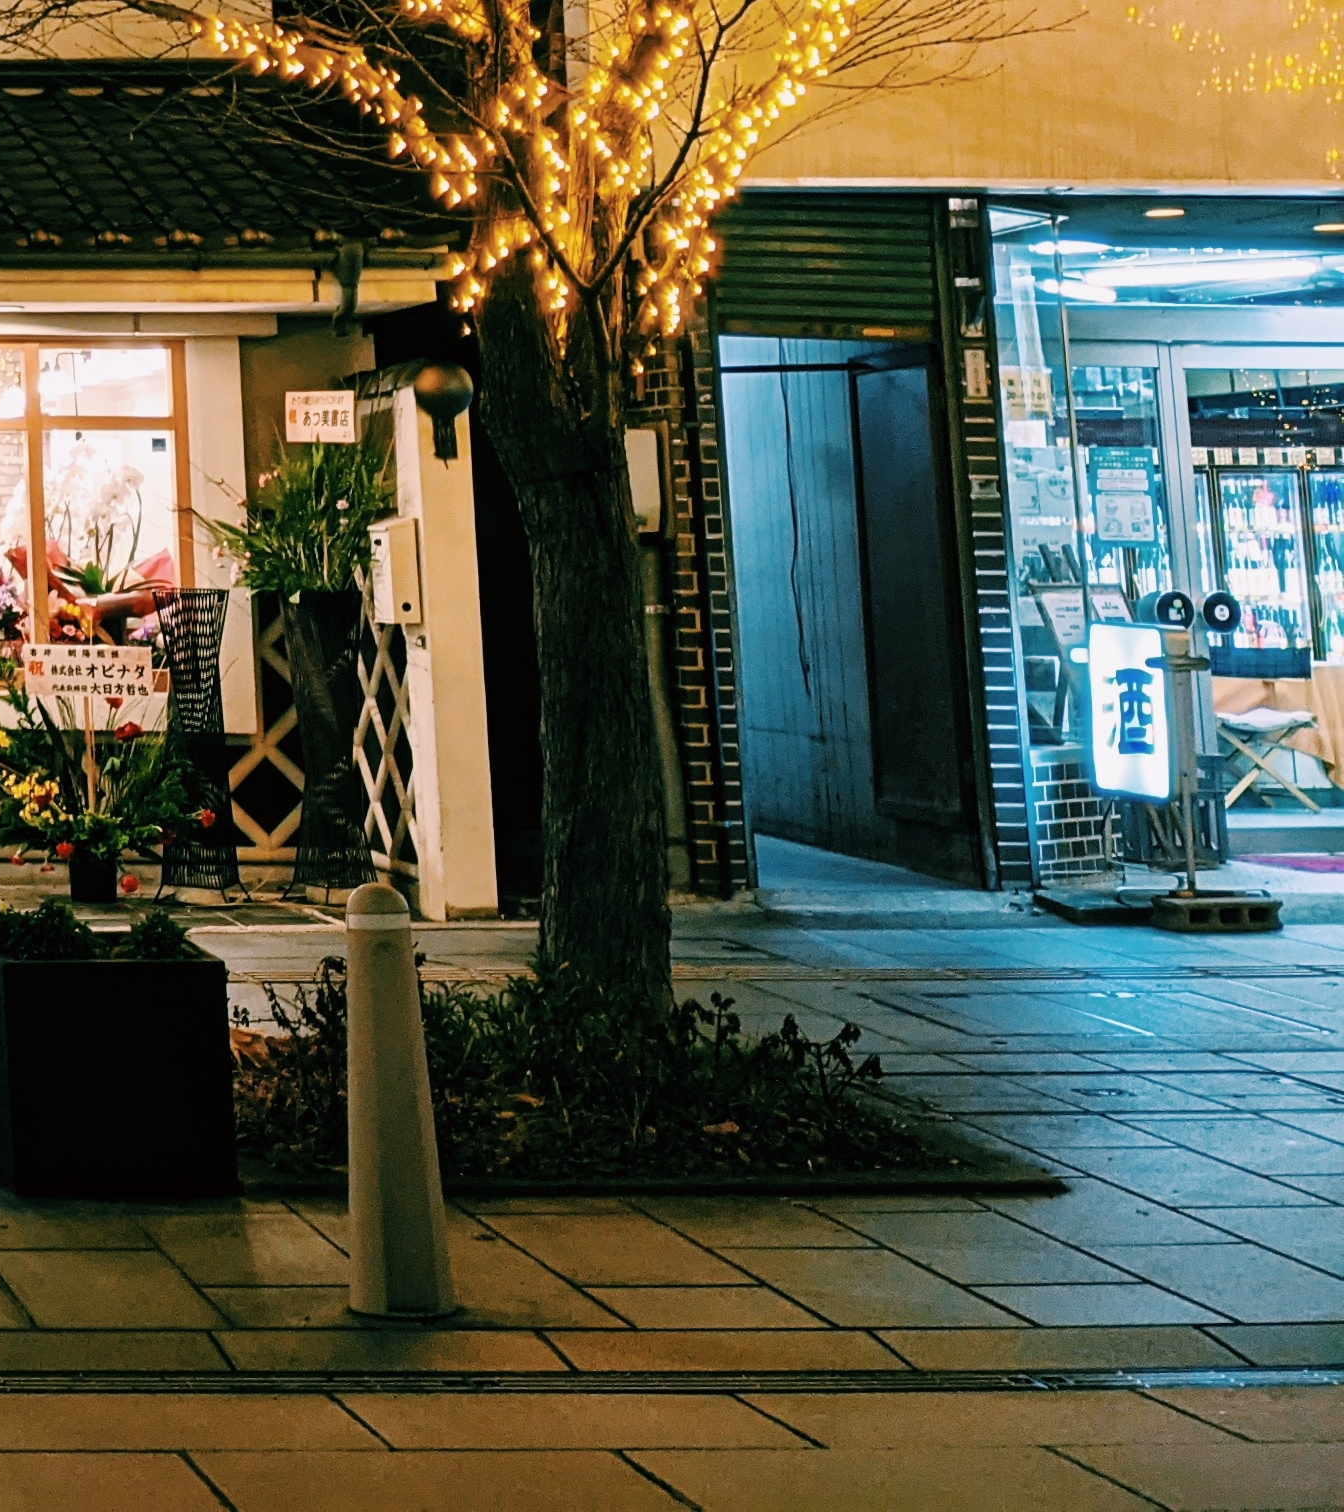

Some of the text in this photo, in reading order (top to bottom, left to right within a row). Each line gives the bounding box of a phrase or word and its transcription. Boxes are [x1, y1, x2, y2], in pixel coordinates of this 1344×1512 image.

[29, 660, 146, 679] 祝 株式会社 オビナタ
[90, 683, 149, 696] 大日方哲也
[1100, 668, 1155, 754] 酒
